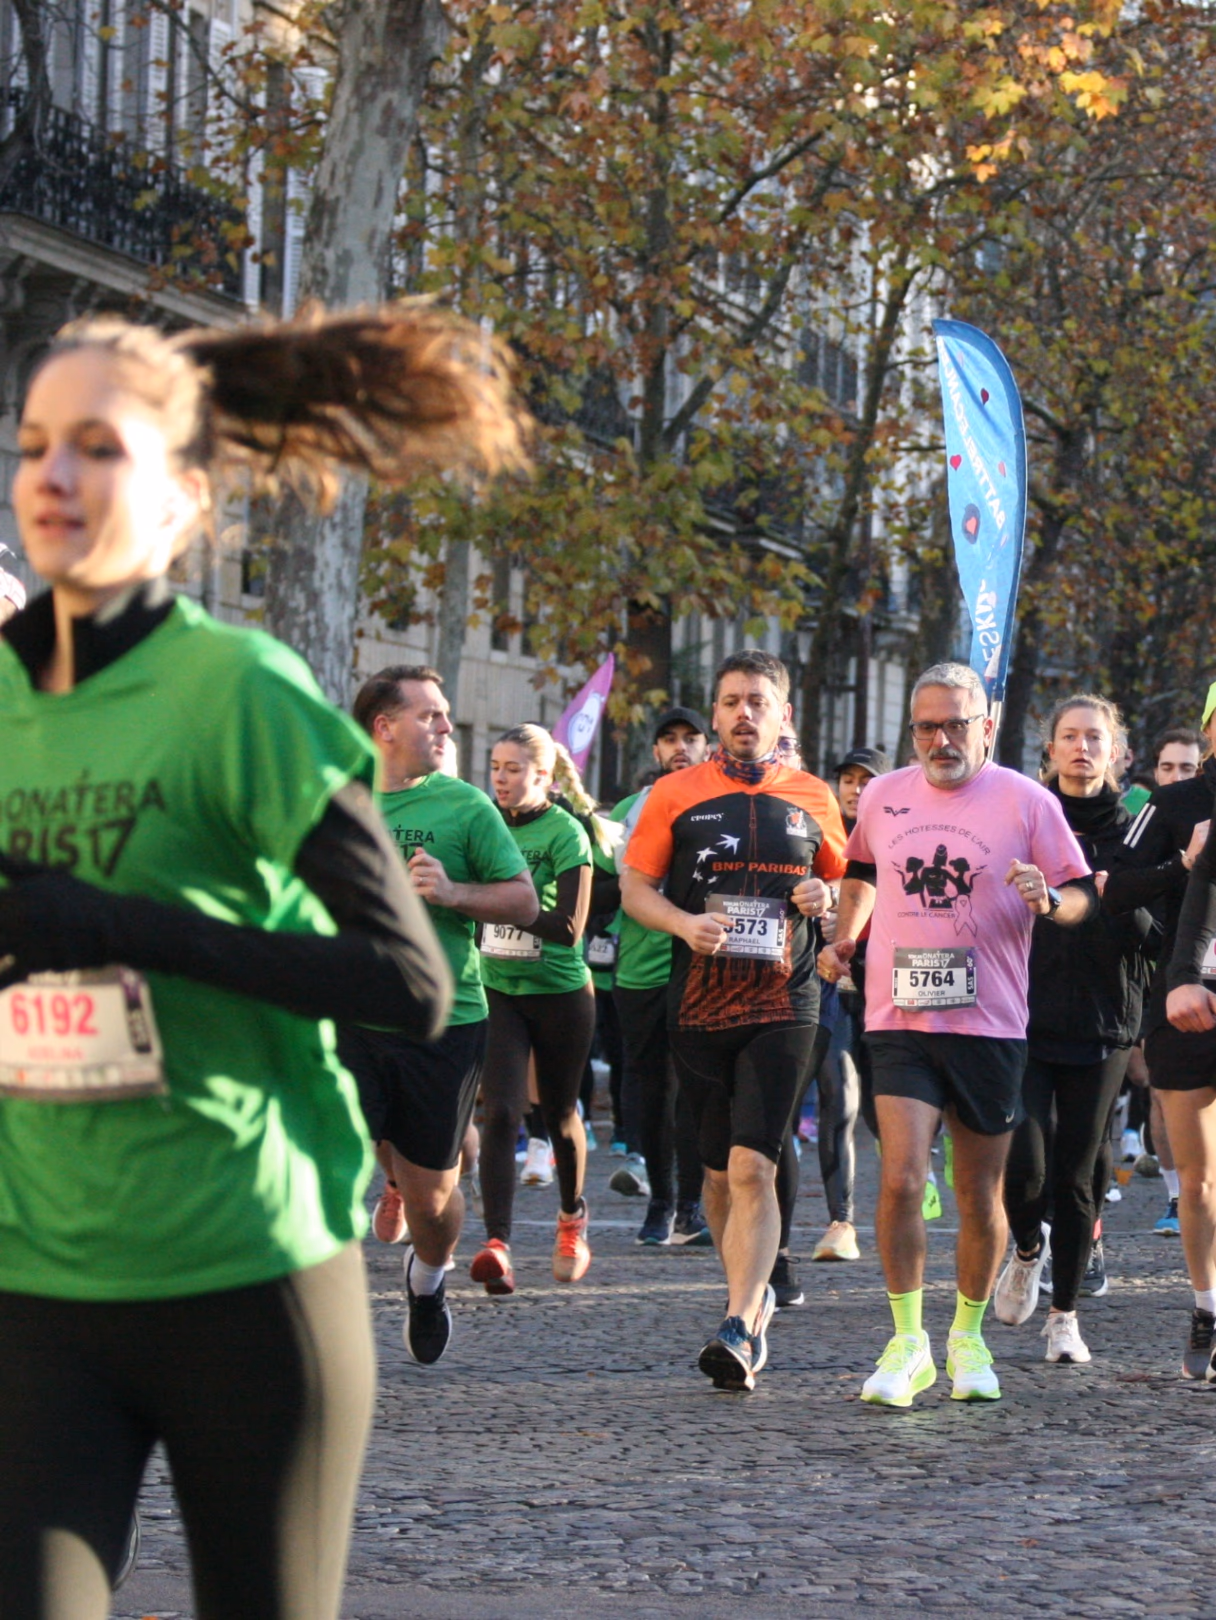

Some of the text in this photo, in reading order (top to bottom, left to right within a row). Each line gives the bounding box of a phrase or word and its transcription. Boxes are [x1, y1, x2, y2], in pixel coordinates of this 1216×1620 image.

[888, 833, 904, 850] LES
[904, 824, 957, 836] HOTESSES
[958, 828, 972, 838] DE
[712, 861, 808, 876] BNP PARIBAS
[728, 936, 761, 944] RAPHAEL
[909, 970, 955, 987] 5764
[9, 992, 100, 1037] 6192
